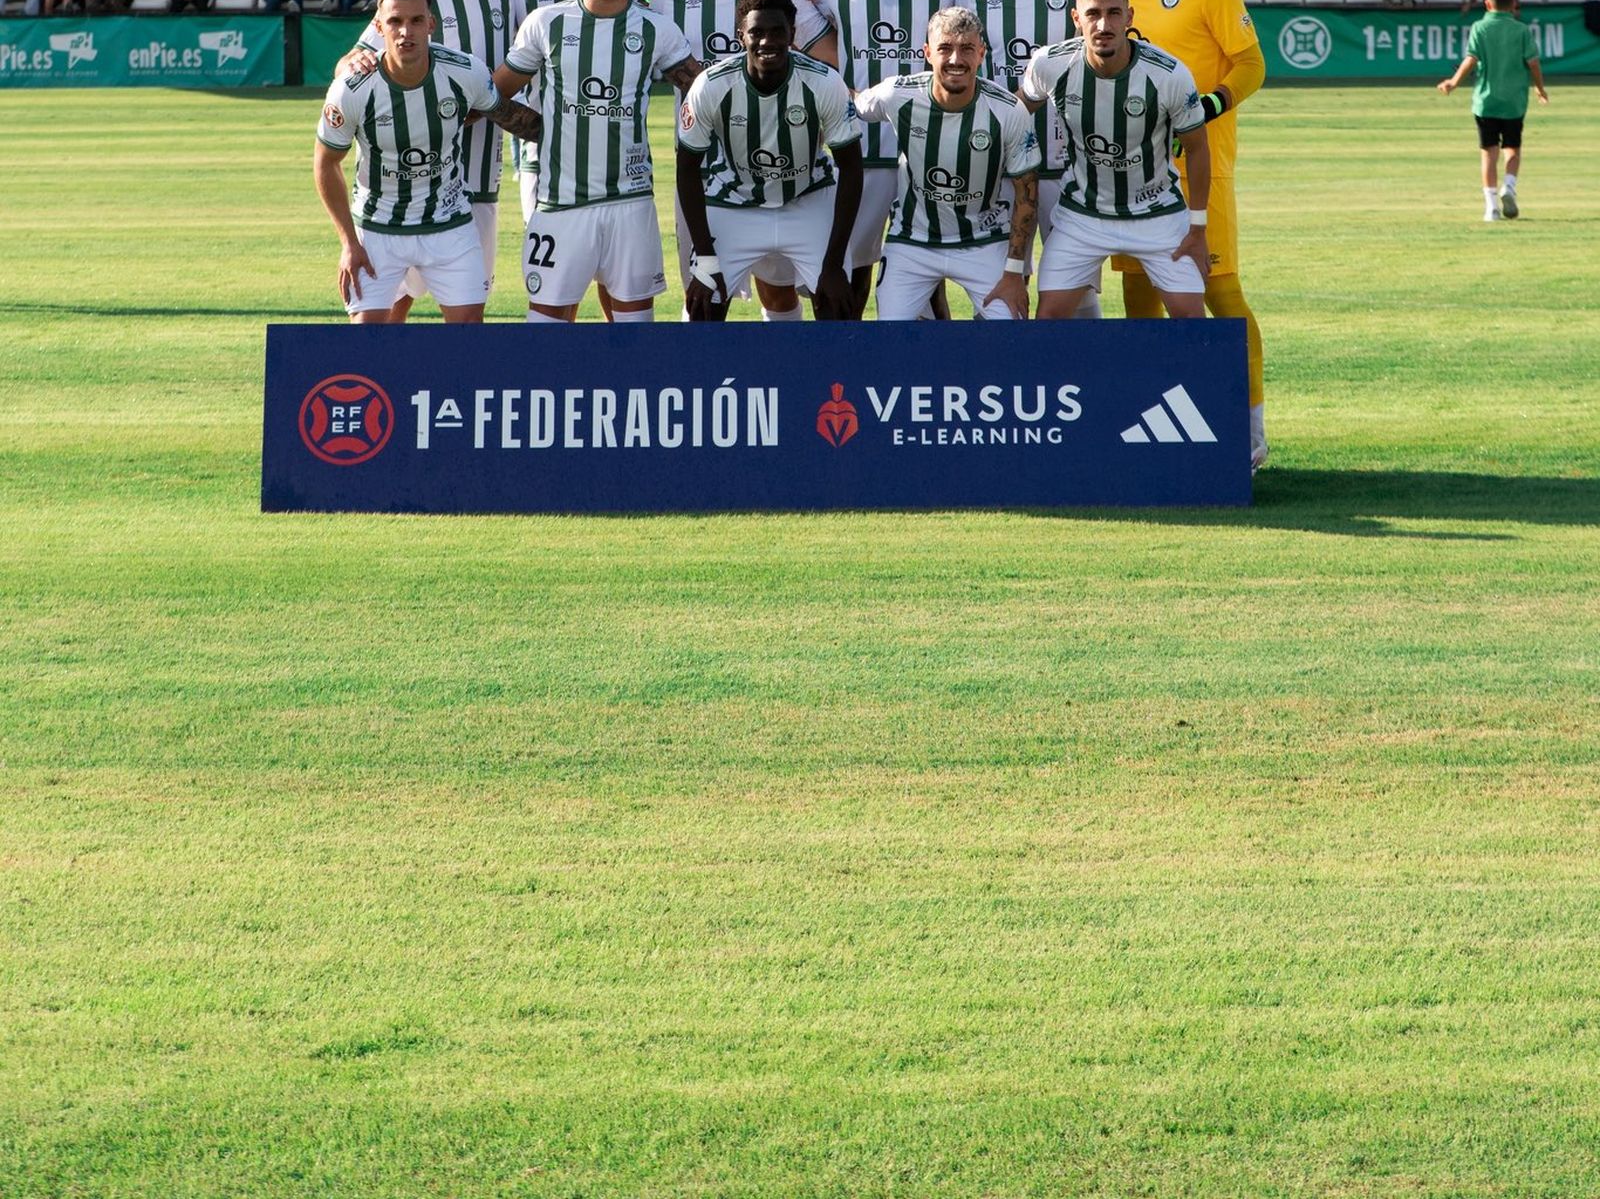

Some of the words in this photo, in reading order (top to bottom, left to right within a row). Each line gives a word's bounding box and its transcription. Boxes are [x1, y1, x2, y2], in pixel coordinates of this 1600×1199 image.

[128, 41, 202, 68] enPie.es
[994, 62, 1027, 76] lims
[527, 232, 556, 268] 22
[332, 406, 362, 418] RF
[474, 377, 779, 449] FEDERACIÓN
[865, 384, 1083, 422] VERSUS
[331, 421, 362, 433] EF
[893, 427, 1063, 446] E-LEARNING
